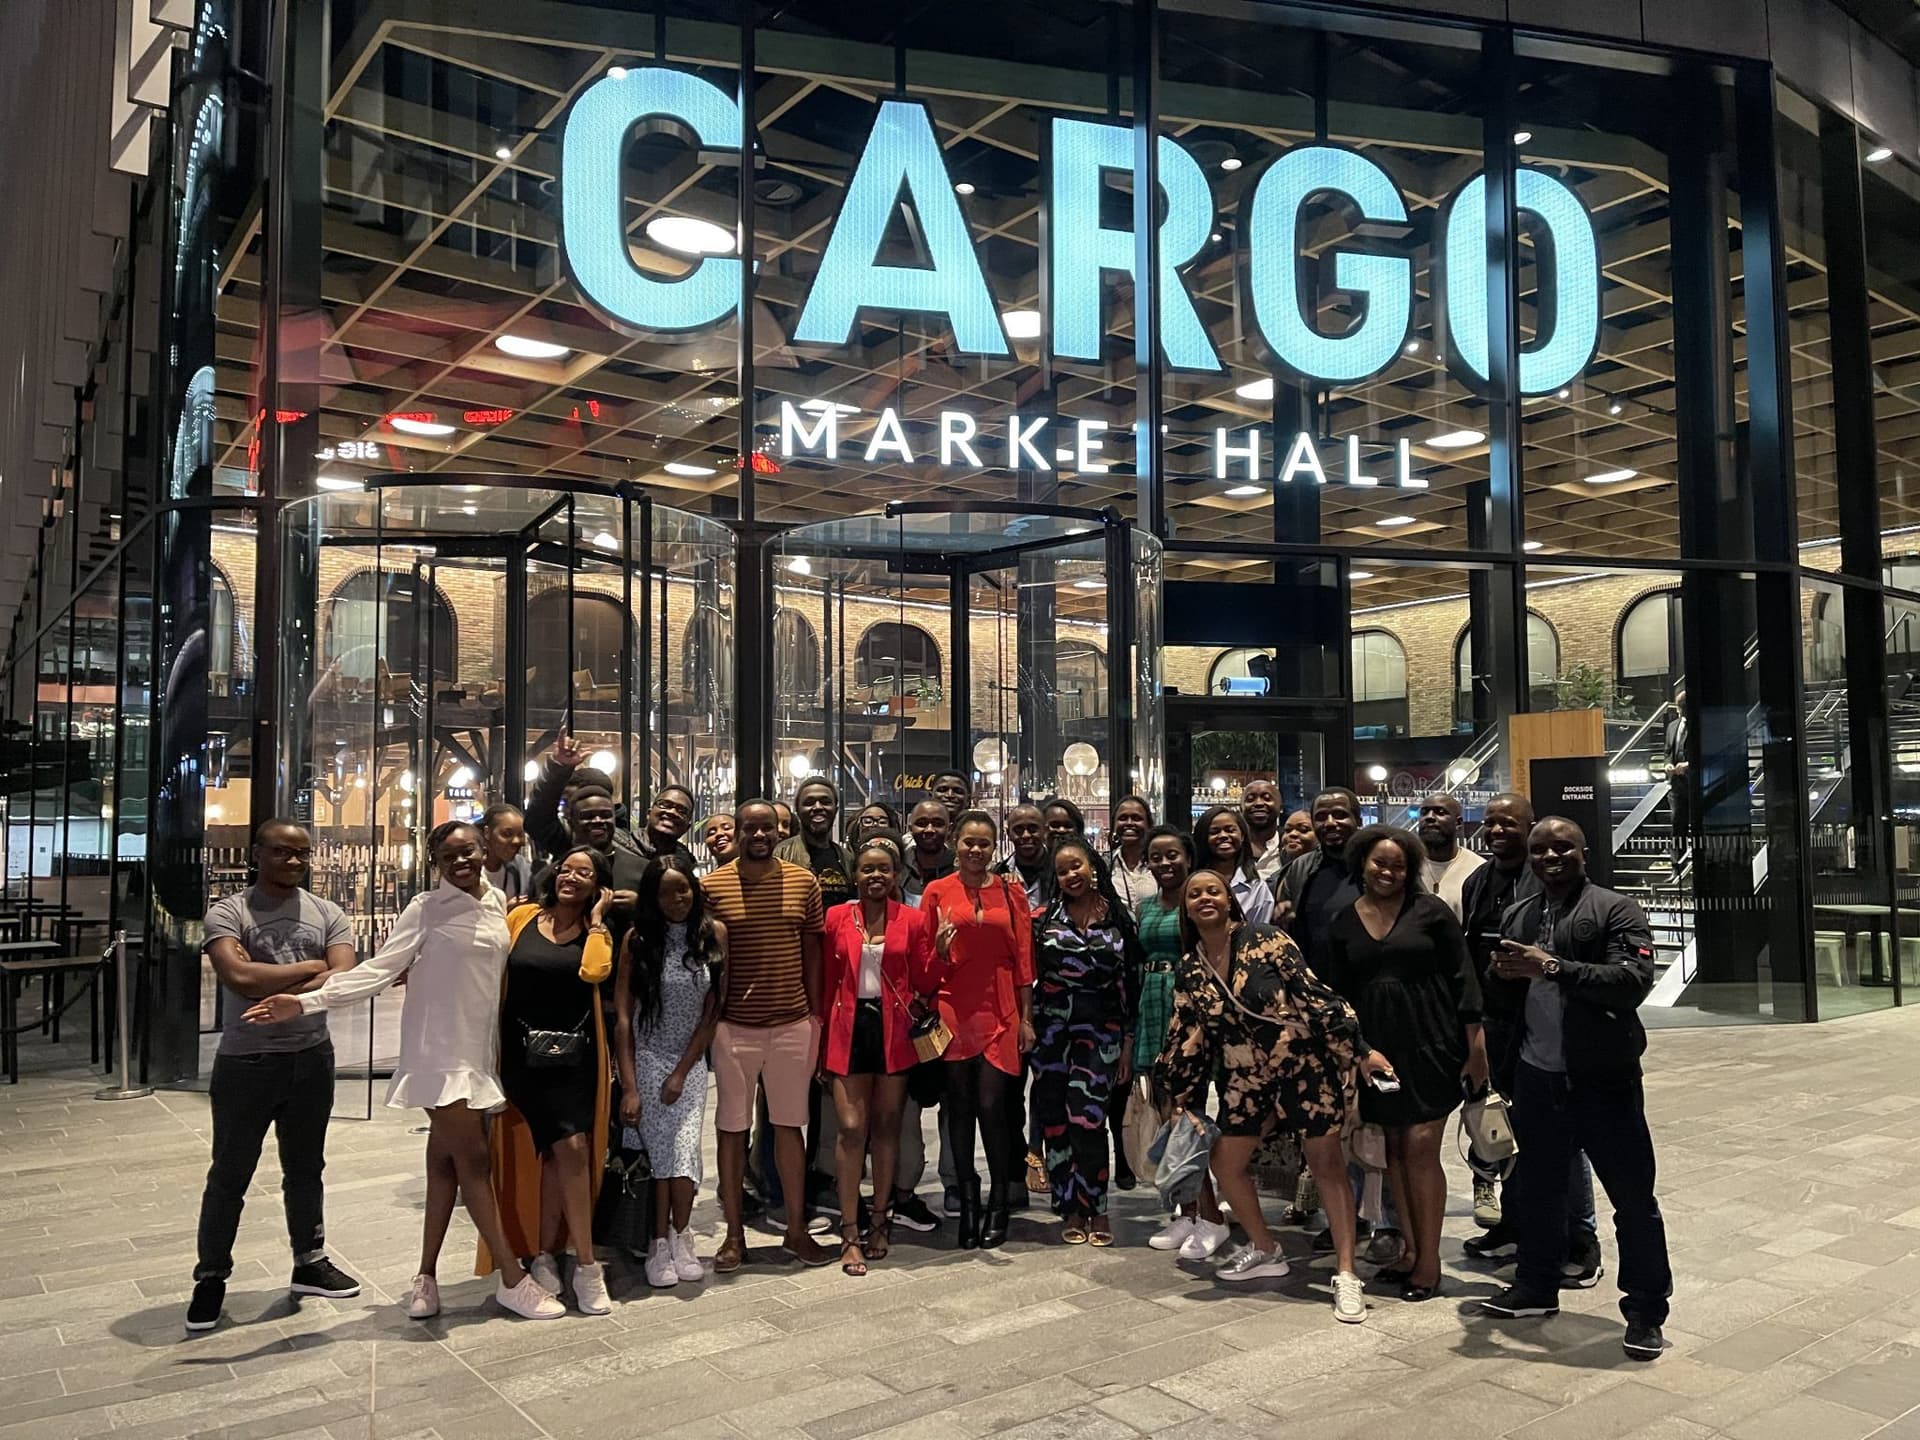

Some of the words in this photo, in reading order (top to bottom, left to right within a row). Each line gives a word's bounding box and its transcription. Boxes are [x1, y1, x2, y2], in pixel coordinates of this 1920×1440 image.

[562, 67, 1600, 395] CARGO
[781, 400, 1168, 473] MARKE
[1217, 429, 1430, 489] HALL
[1516, 758, 1526, 792] ARGO
